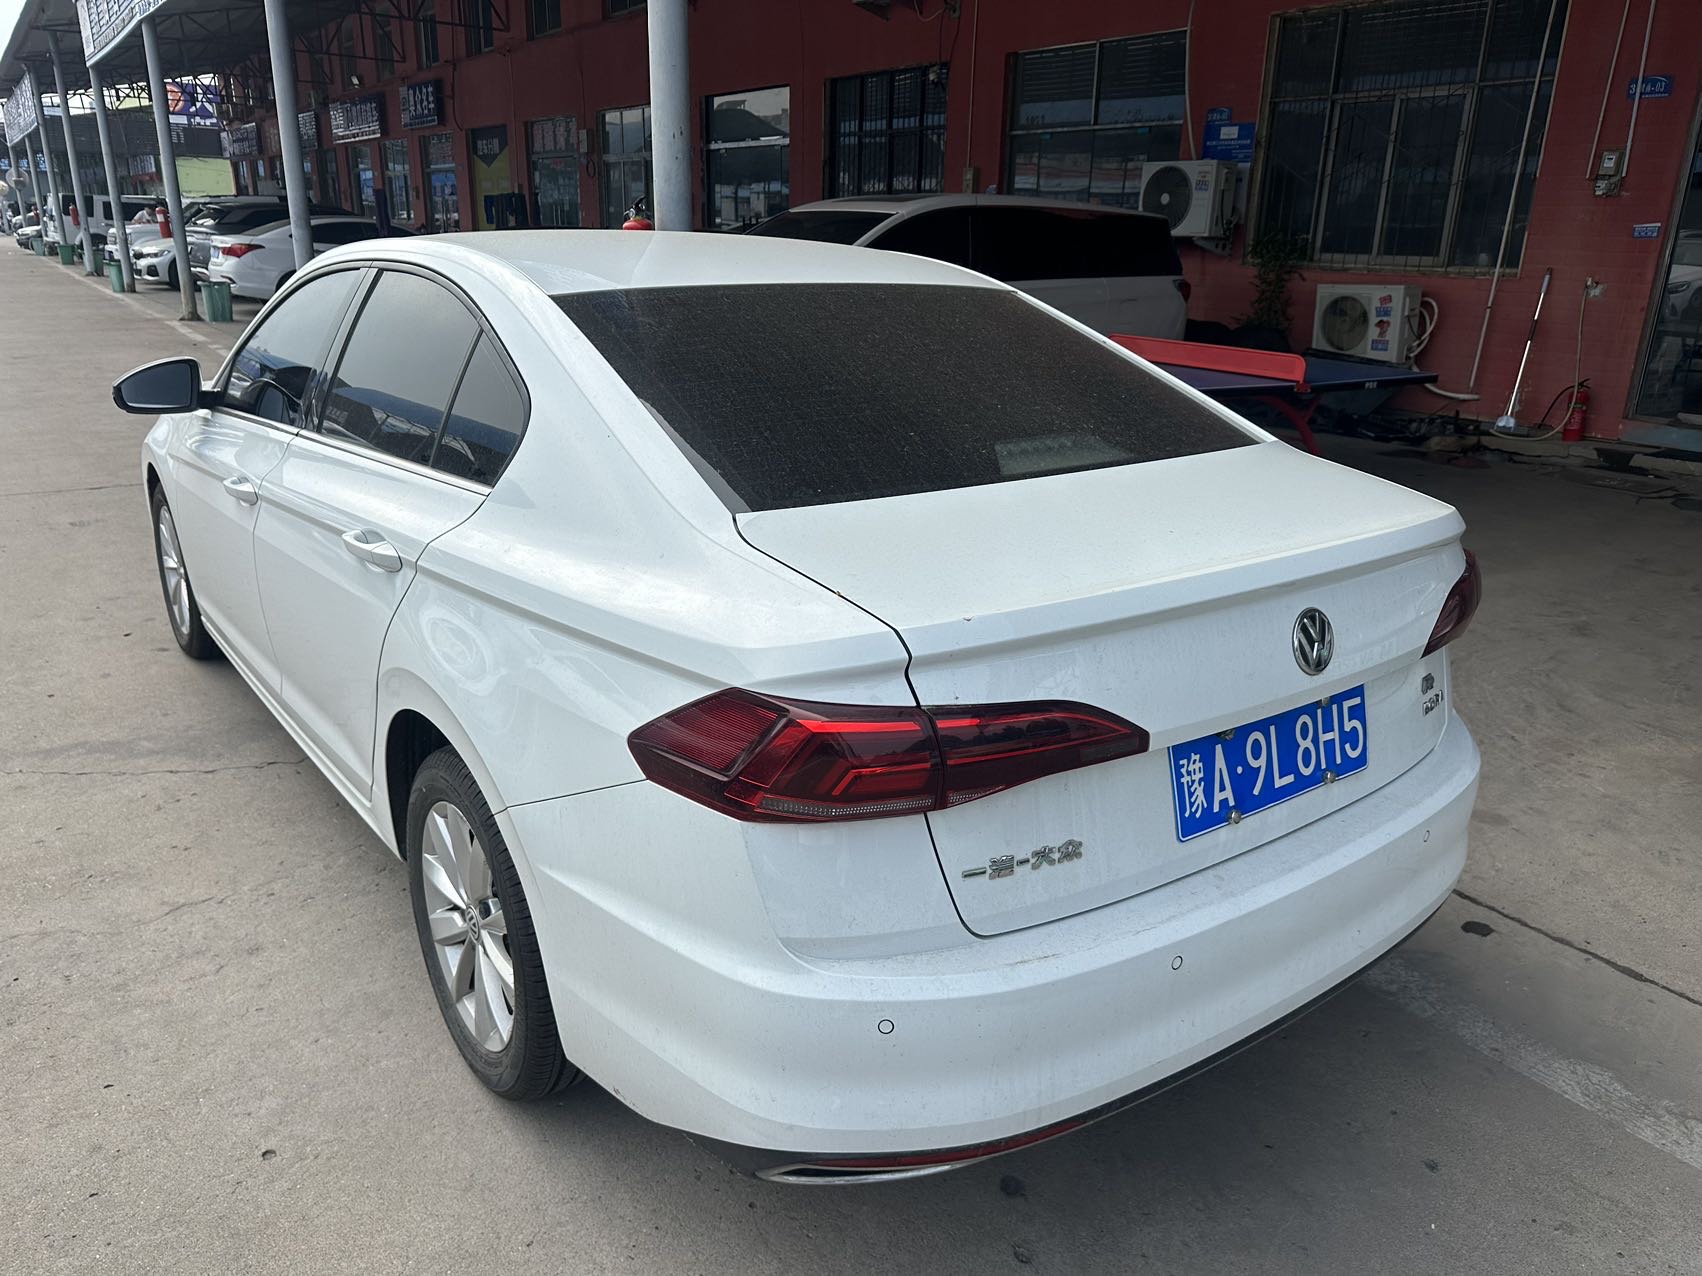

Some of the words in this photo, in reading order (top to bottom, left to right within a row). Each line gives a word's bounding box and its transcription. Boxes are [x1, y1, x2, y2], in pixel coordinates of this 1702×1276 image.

[1179, 696, 1365, 818] 豫A·9L8H5
[961, 839, 1083, 880] 一汽-大众
